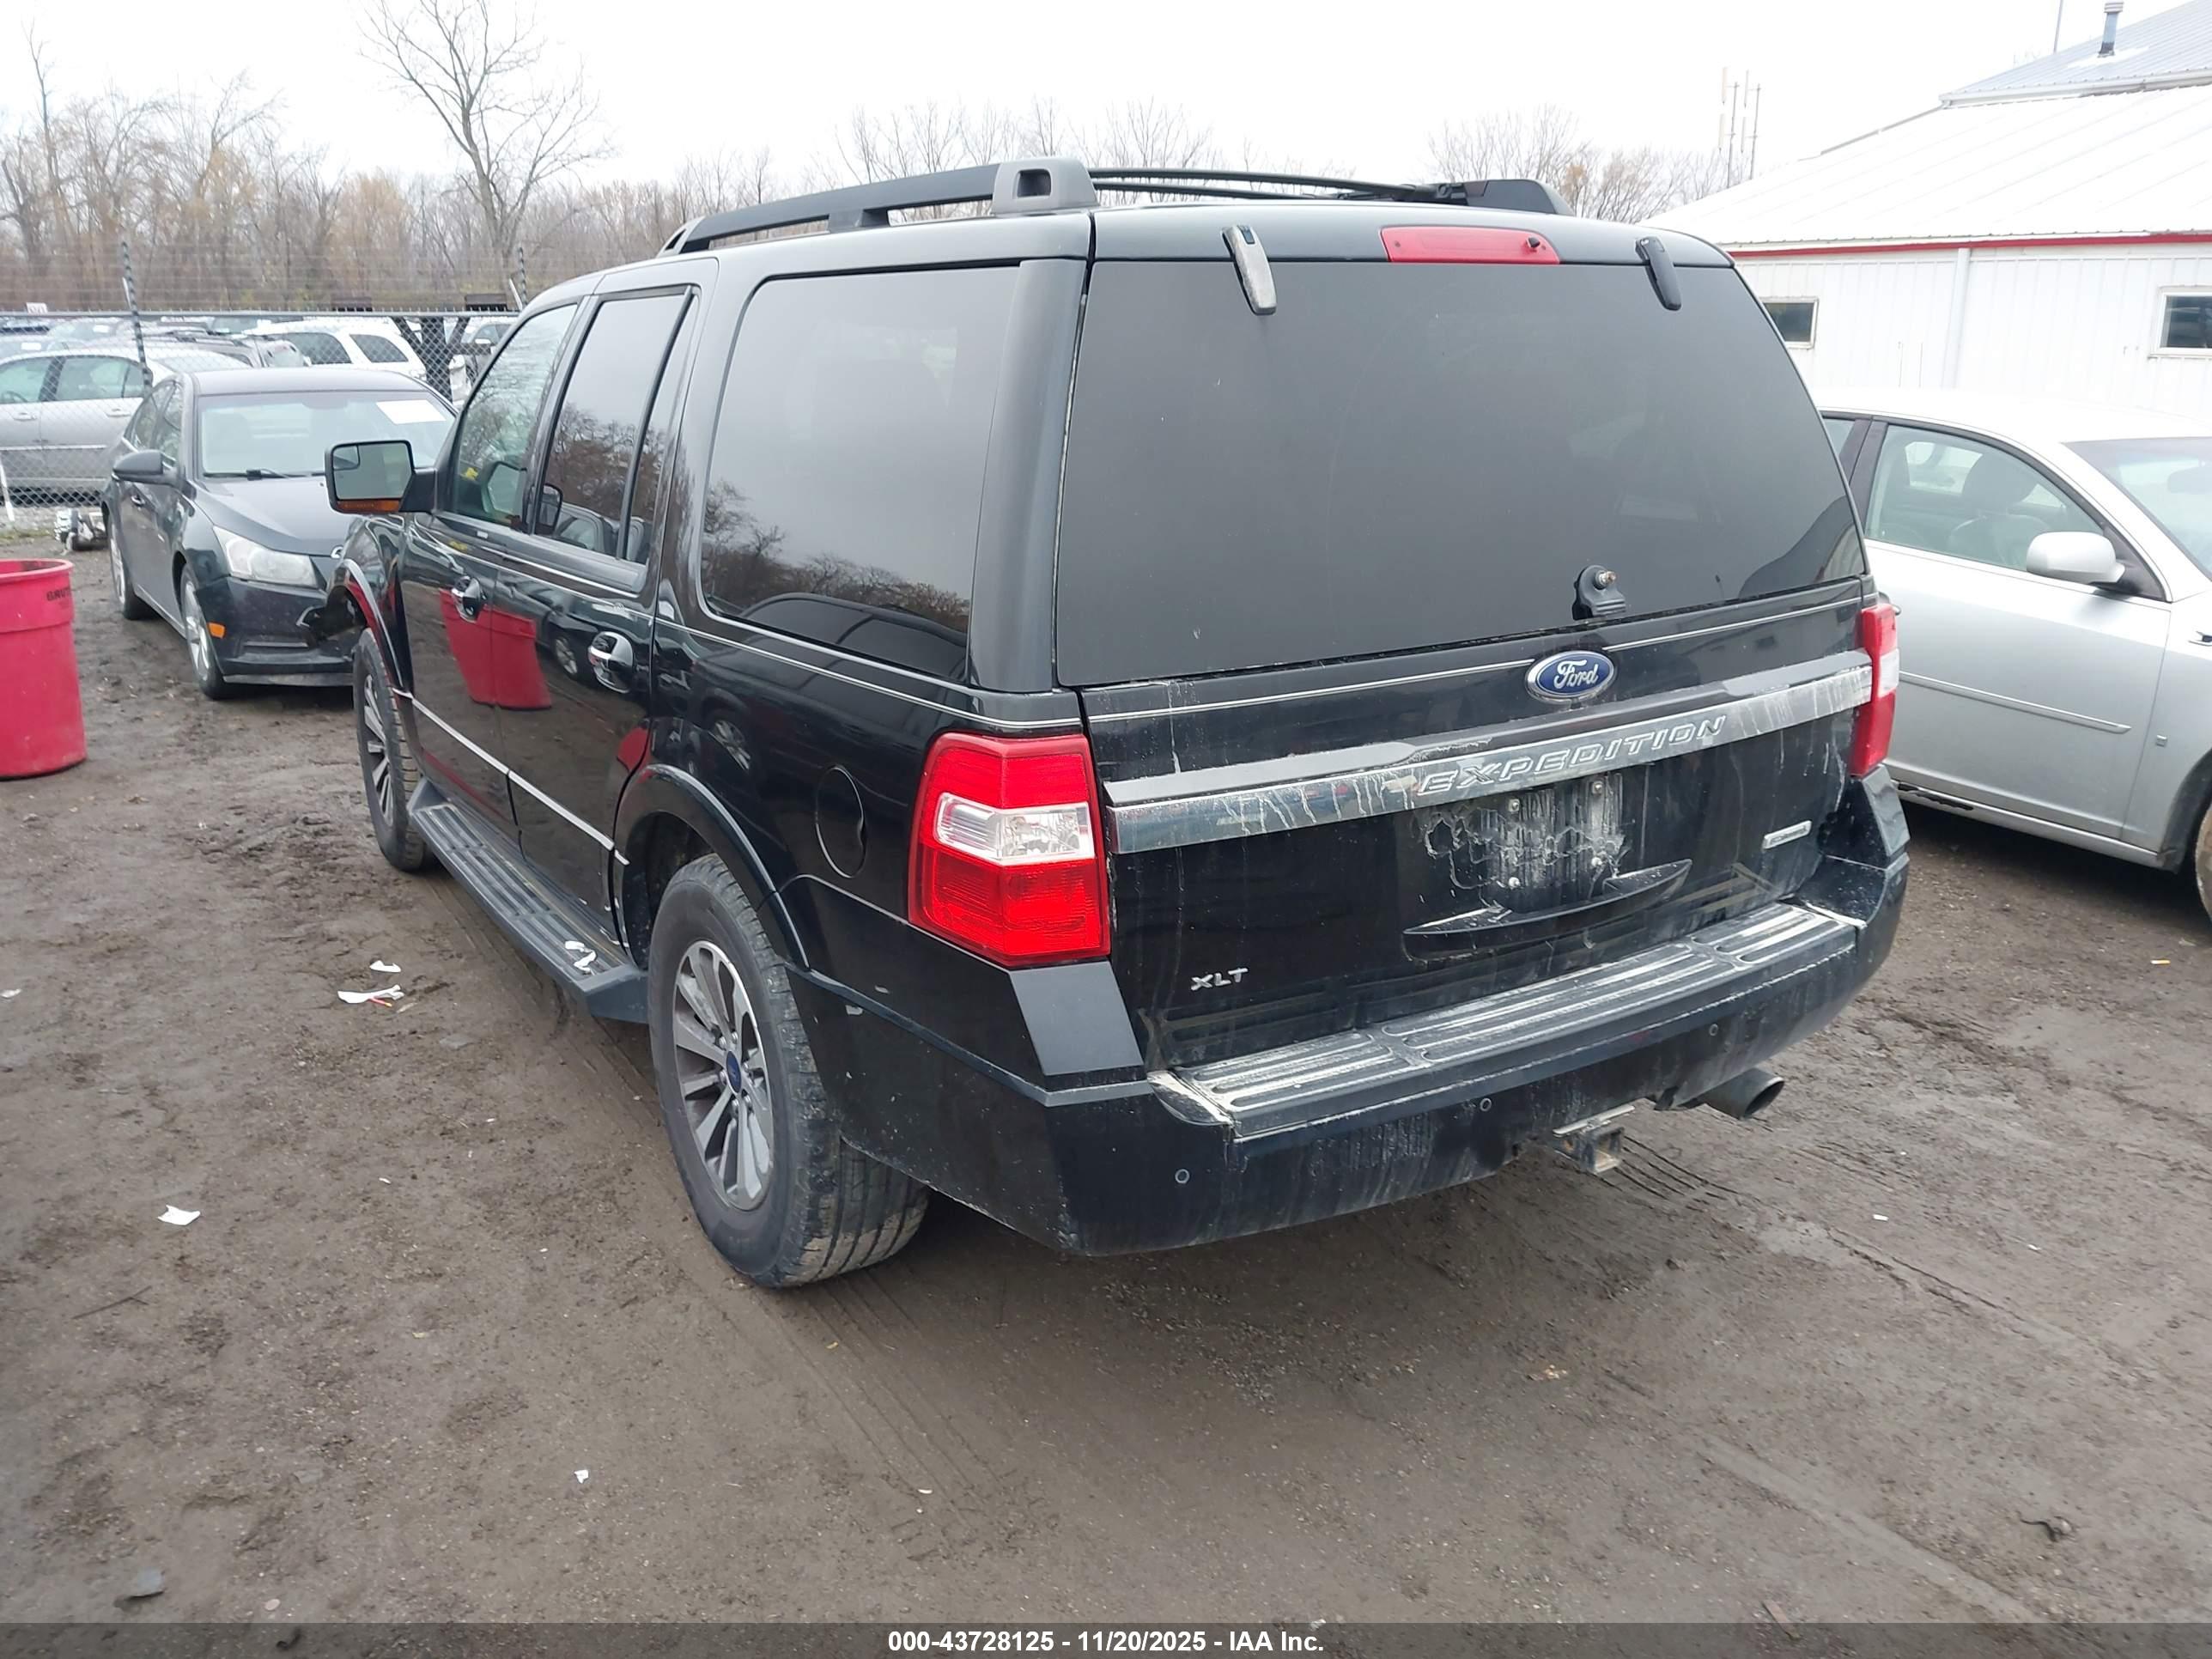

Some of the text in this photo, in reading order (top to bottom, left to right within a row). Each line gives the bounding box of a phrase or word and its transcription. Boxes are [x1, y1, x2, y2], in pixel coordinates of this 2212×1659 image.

[1553, 659, 1599, 690] Ford
[1416, 714, 1727, 796] EXPEDITION
[1190, 967, 1249, 991] XLT
